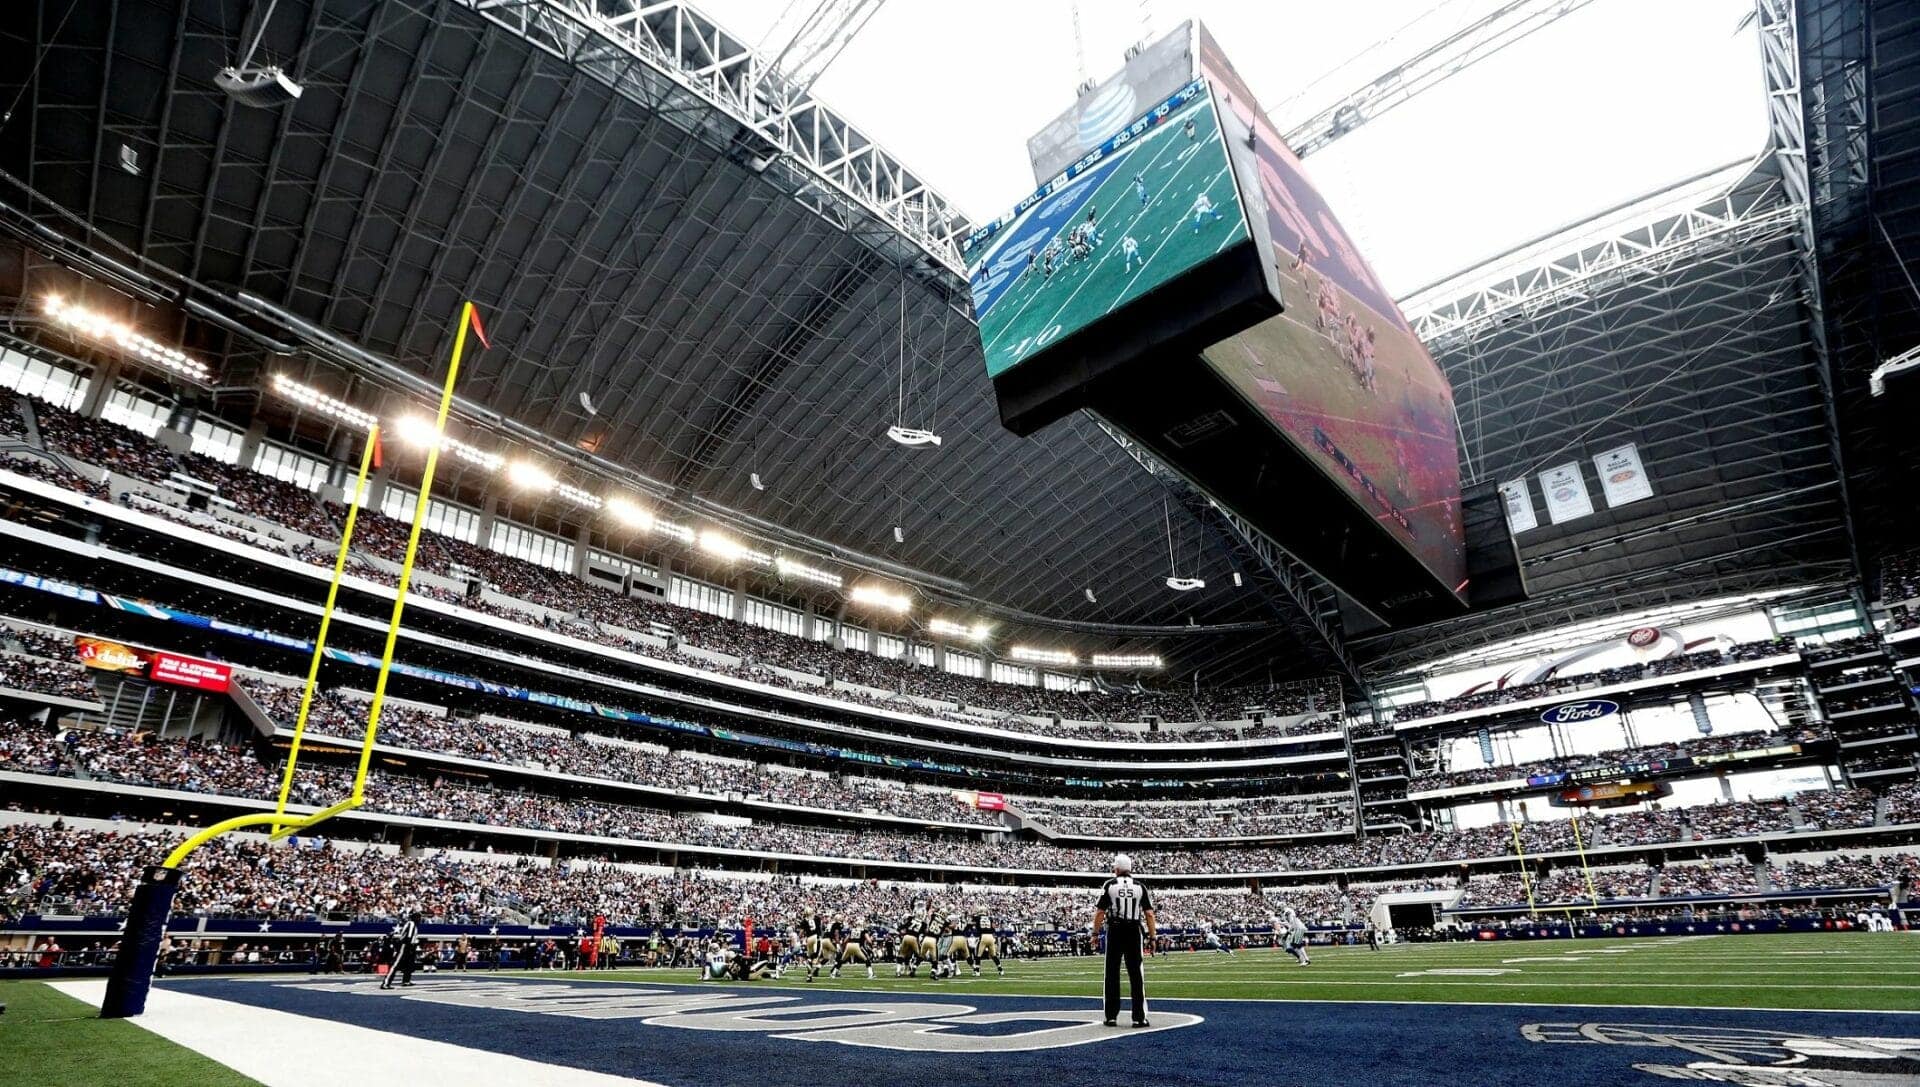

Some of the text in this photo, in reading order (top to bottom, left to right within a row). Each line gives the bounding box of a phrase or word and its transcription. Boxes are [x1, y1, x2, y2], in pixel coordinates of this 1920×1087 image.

[1020, 192, 1042, 211] DAL
[1074, 148, 1104, 173] 5:32
[1556, 703, 1603, 722] Ford
[1118, 888, 1134, 898] 65
